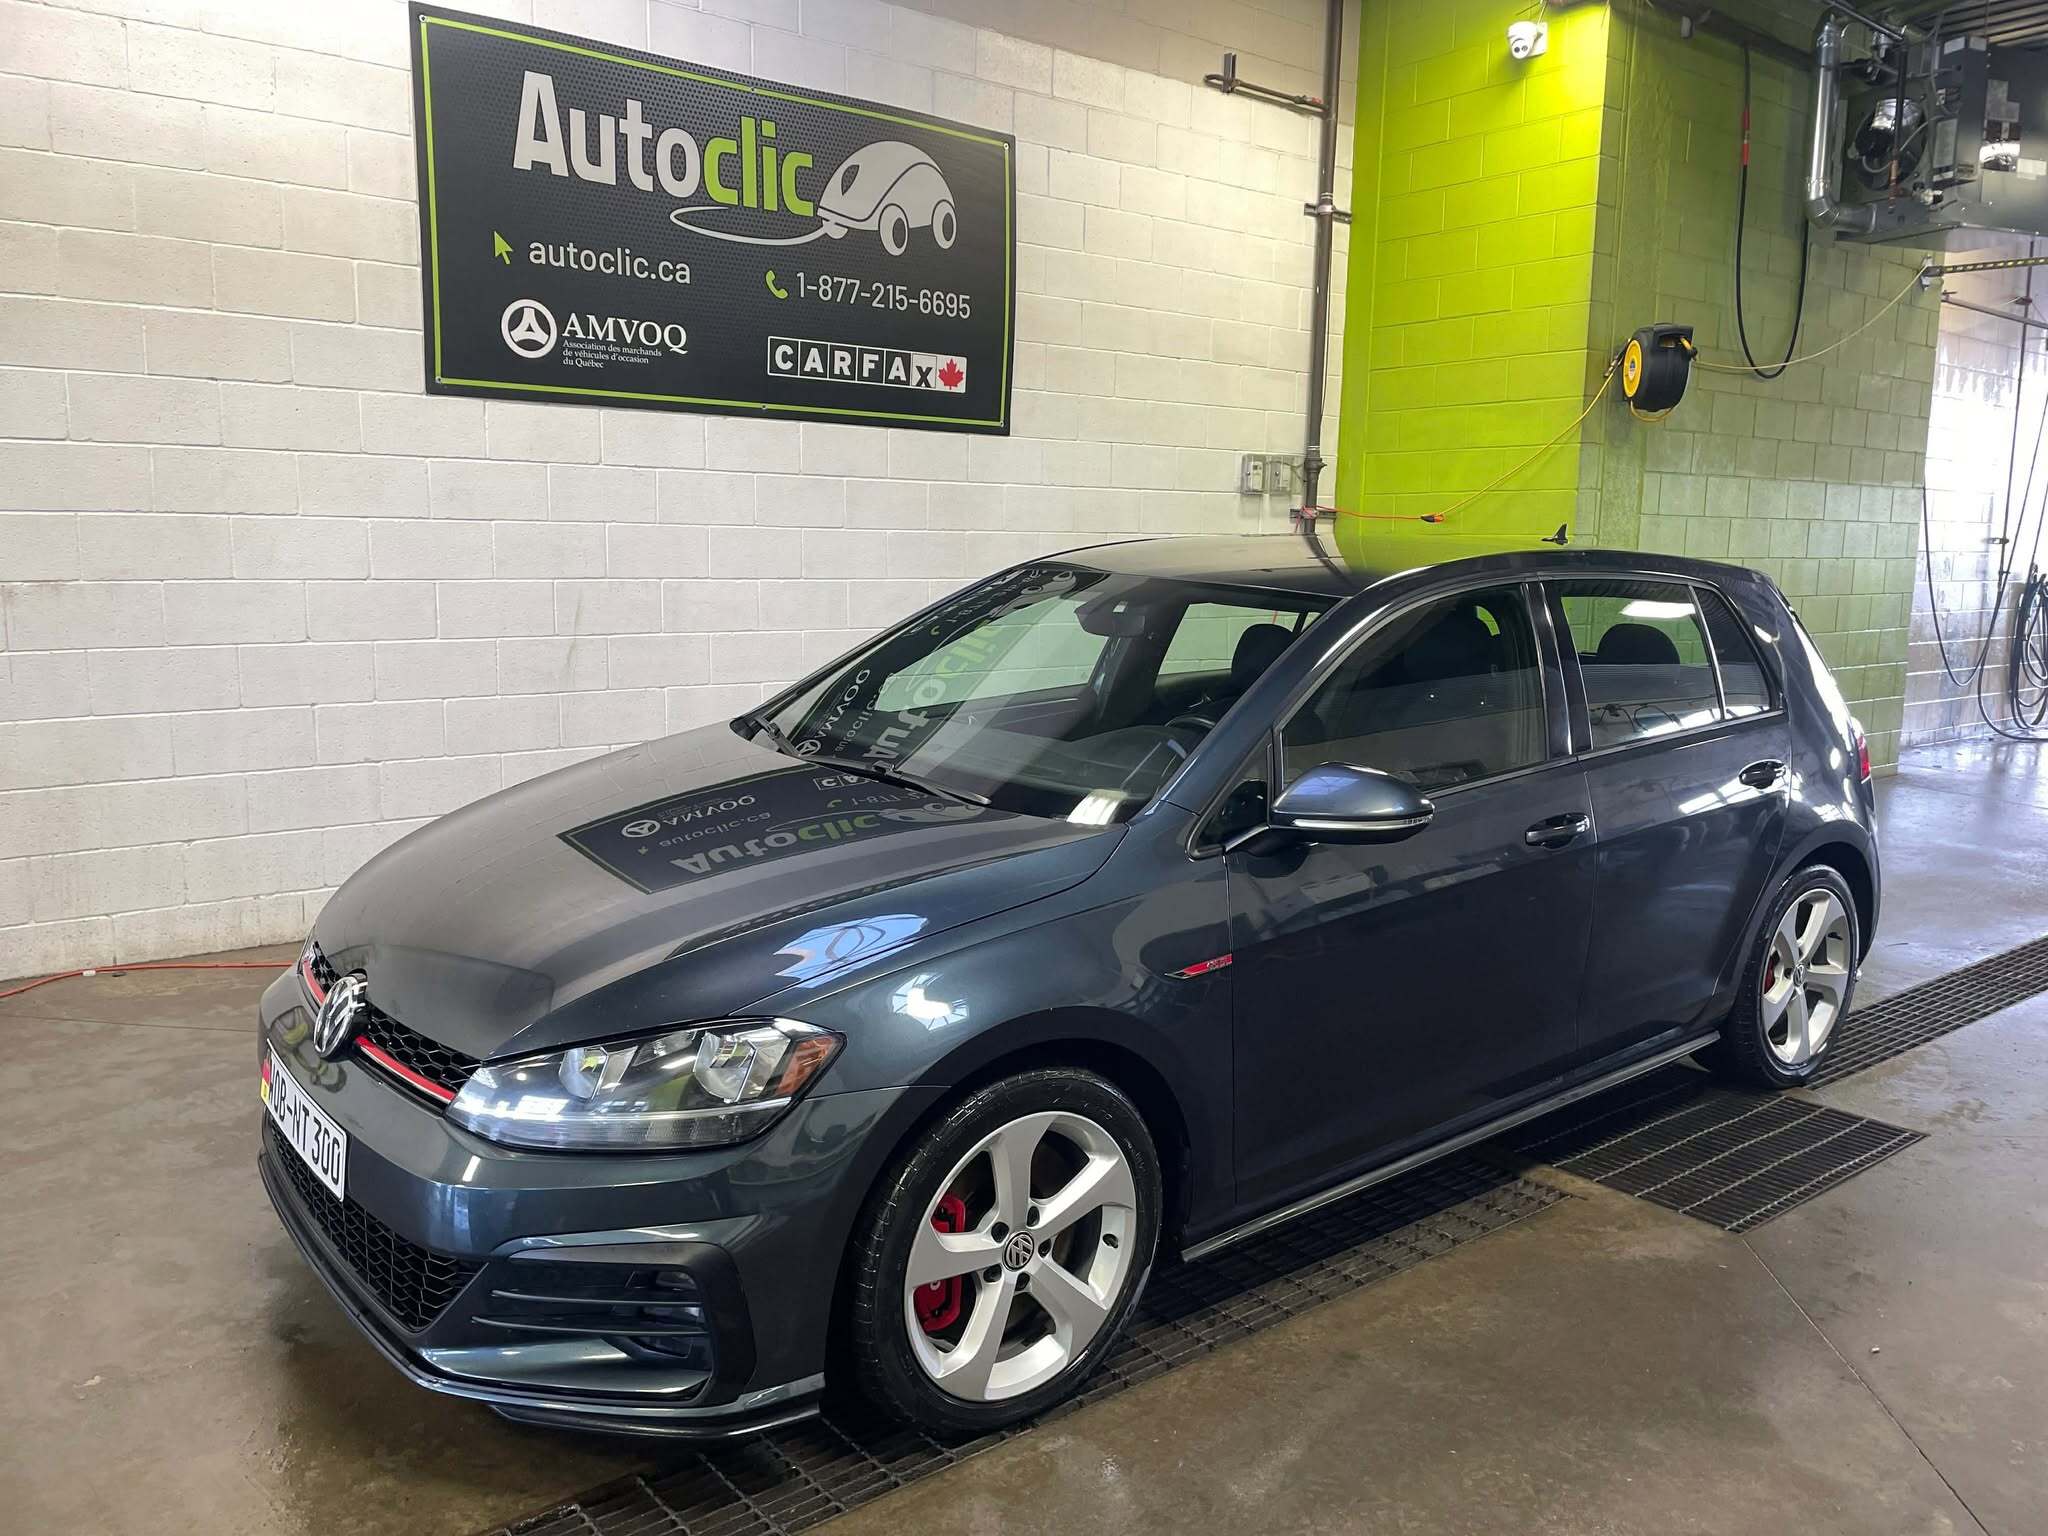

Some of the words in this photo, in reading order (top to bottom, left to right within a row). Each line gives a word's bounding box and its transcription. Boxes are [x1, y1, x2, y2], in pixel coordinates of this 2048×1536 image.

[513, 70, 814, 216] Autoclic
[529, 241, 691, 285] autoclic.ca
[796, 271, 971, 319] 1-877-215-6695
[562, 312, 688, 354] AMVOQ
[562, 339, 607, 351] Association
[608, 344, 621, 352] des
[622, 346, 663, 357] marchands
[562, 348, 573, 357] de
[574, 350, 609, 361] véhicules
[562, 357, 574, 365] du
[575, 357, 604, 368] Québec
[774, 344, 933, 388] CARFAX
[311, 1117, 341, 1187] 300
